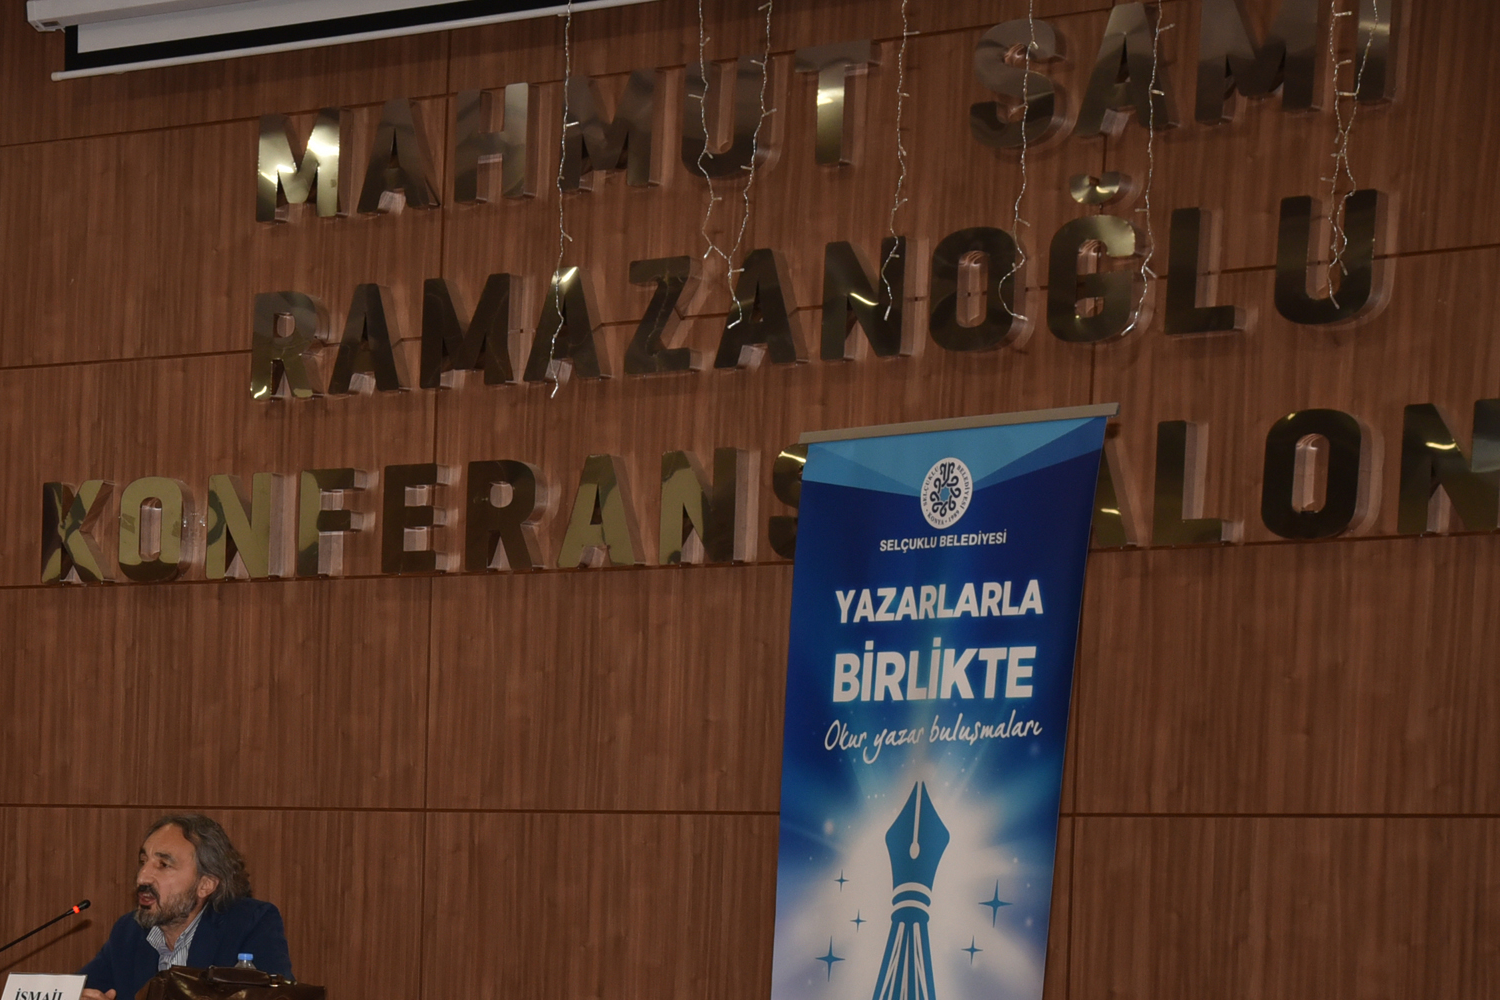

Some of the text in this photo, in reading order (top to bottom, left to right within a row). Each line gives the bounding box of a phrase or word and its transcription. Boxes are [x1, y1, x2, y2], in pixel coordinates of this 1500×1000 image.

[256, 41, 878, 223] MAHMUT
[251, 172, 1384, 399] RAMAZANOĞLU
[879, 528, 1007, 553] SELÇUKLU BELEDİYESİ
[835, 579, 1044, 624] YAZARLARLA
[832, 637, 1037, 702] BİRLİKTE
[824, 709, 1043, 765] Okur yazar buluşmaları
